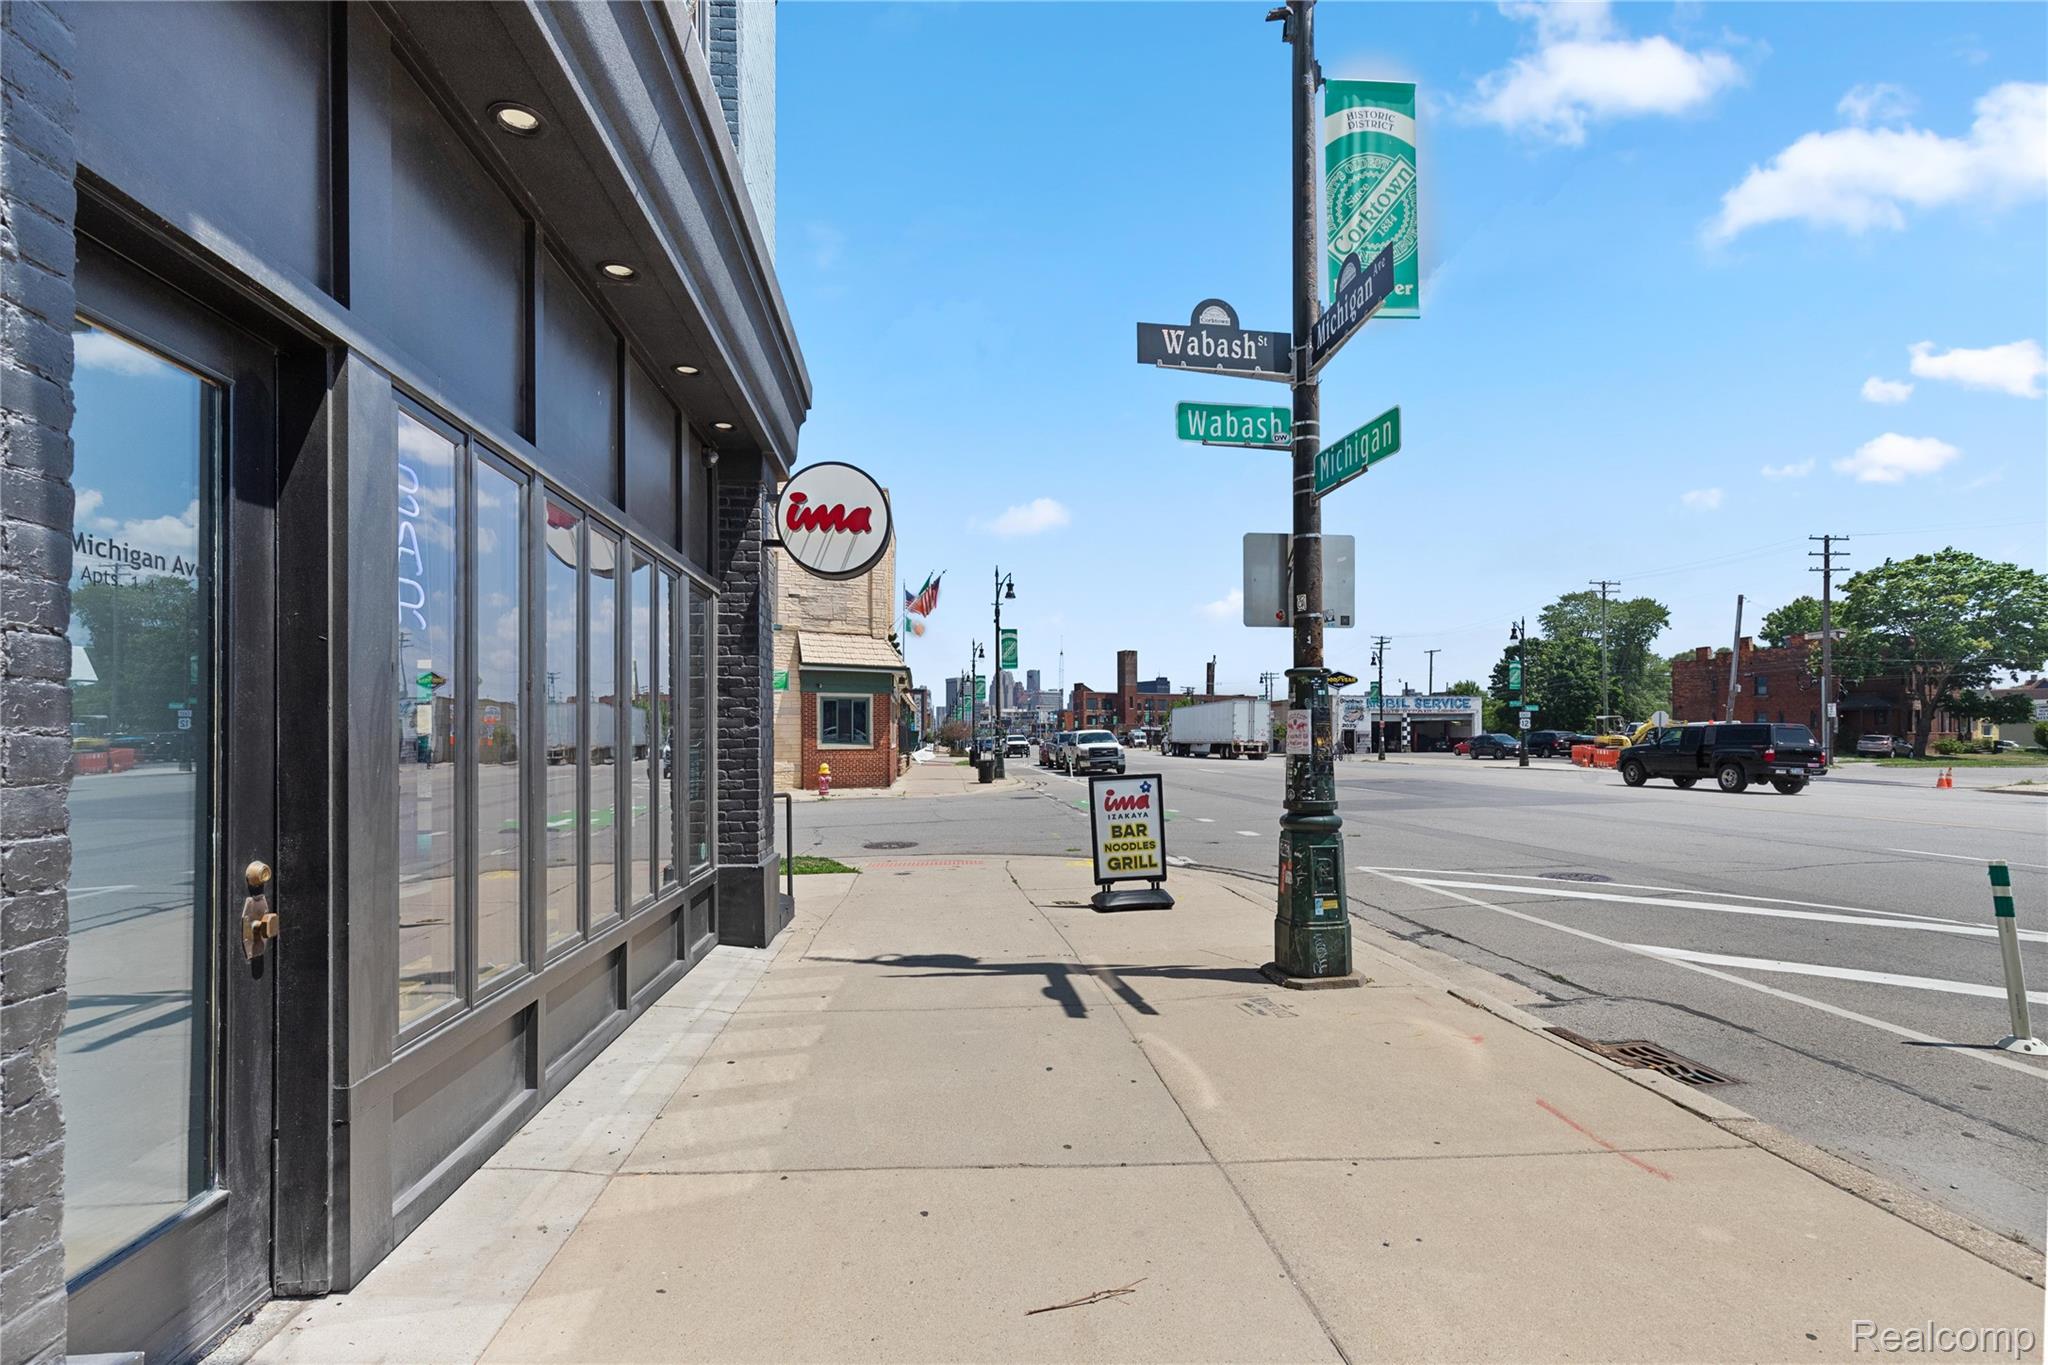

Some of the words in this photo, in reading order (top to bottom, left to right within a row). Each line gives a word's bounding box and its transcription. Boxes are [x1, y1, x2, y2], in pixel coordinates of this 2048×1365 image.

[1346, 110, 1396, 123] HISTORIC
[1347, 120, 1395, 131] DISTRICT
[1344, 183, 1370, 208] Since
[1333, 166, 1413, 256] Corktown
[1316, 276, 1374, 351] Michigan
[1161, 328, 1257, 360] Wabash
[1257, 334, 1268, 347] St
[1187, 409, 1283, 439] Wabash
[1320, 420, 1392, 482] Michigan
[786, 491, 873, 535] ima
[80, 565, 123, 588] Apts.
[1414, 697, 1472, 710] SERVICE
[1104, 789, 1150, 812] ima
[1107, 812, 1149, 821] IZAKAYA
[1111, 823, 1148, 839] BAR
[1104, 840, 1156, 853] NOODLES
[1107, 854, 1158, 871] GRILL
